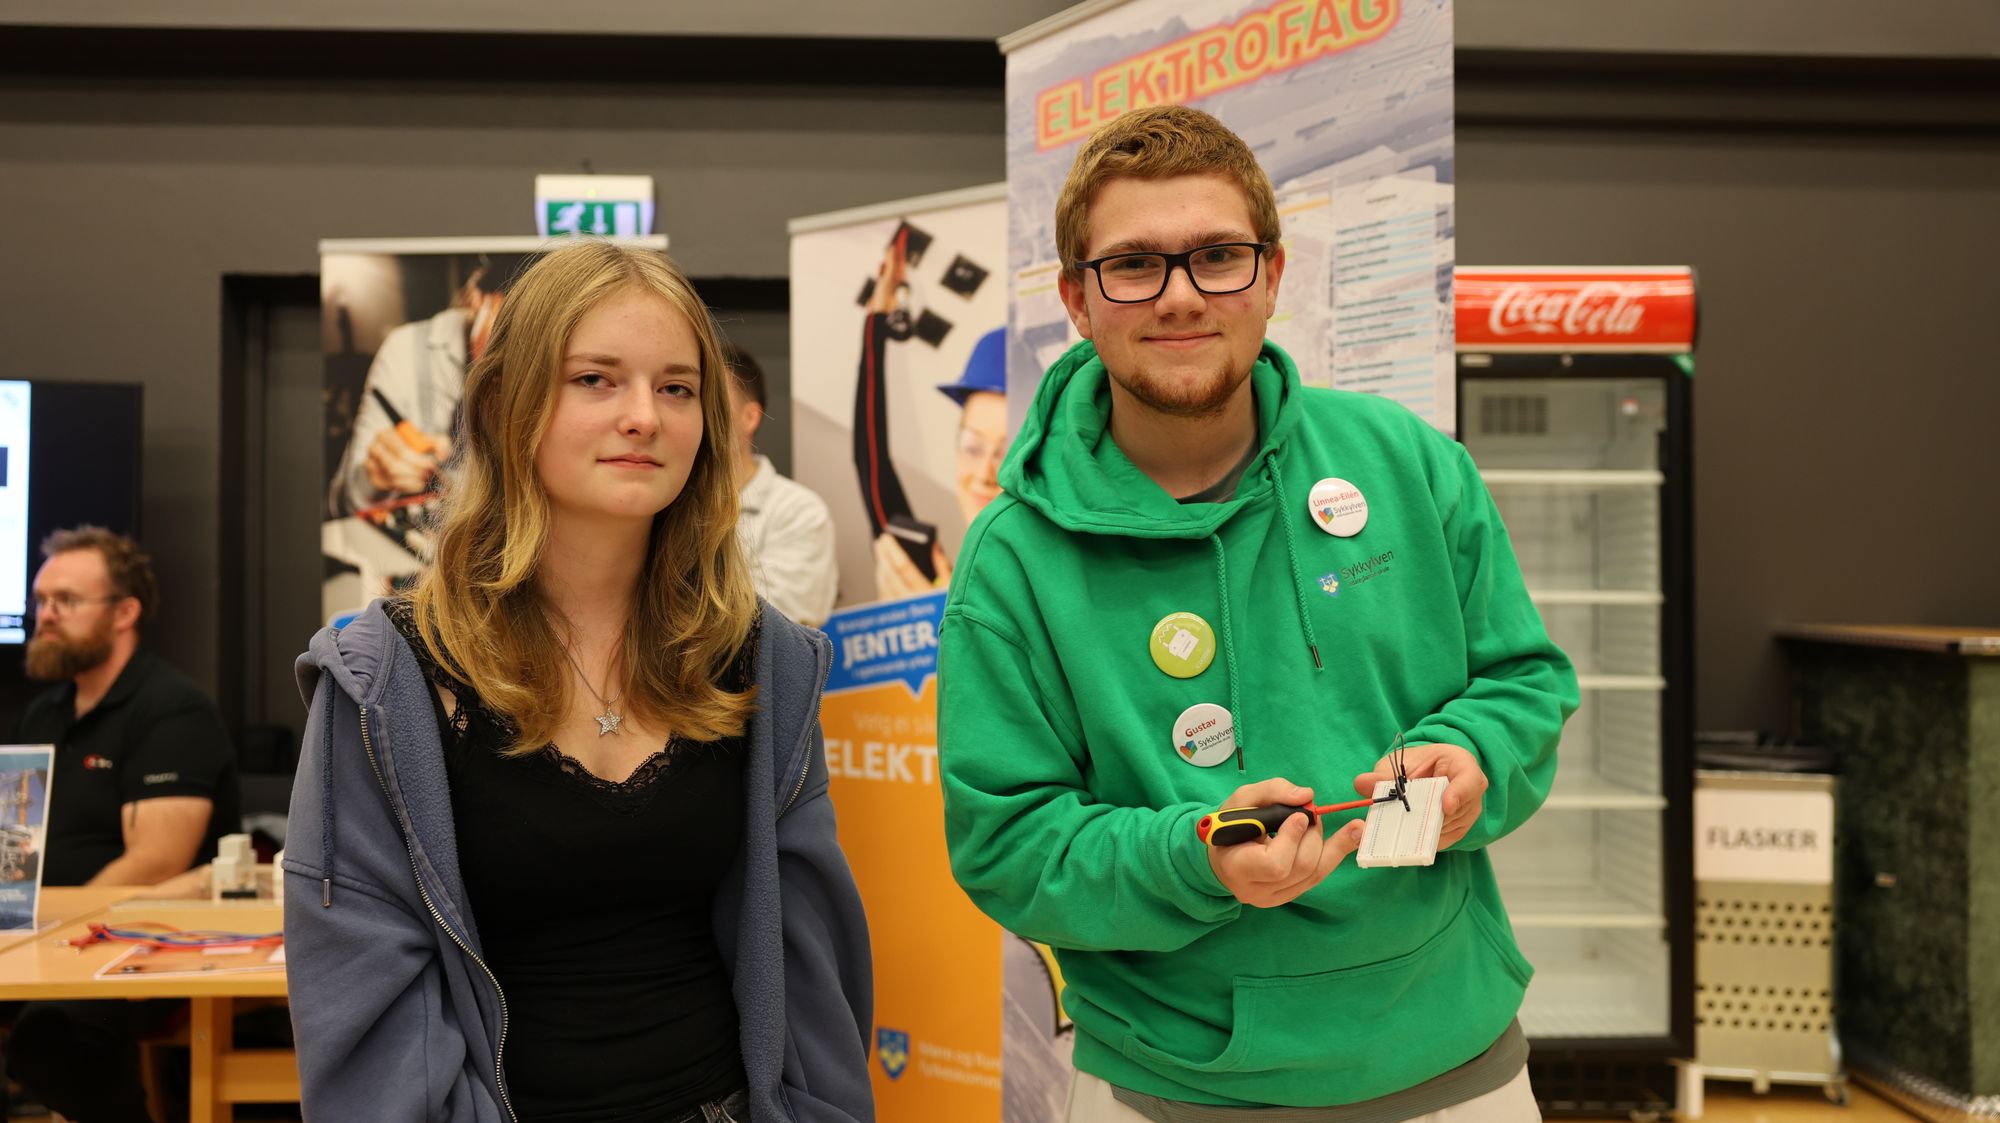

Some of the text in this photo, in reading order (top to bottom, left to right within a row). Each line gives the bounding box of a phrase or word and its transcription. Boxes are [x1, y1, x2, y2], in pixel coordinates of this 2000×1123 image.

[1041, 0, 1396, 142] ELEKTROFAG
[1488, 281, 1648, 336] Coca-Cola
[1333, 501, 1366, 515] Sykkylven
[1341, 550, 1394, 580] Sykkylven
[842, 620, 938, 671] JENTER
[1185, 718, 1216, 738] Gustav
[1197, 725, 1235, 748] Sykkylven
[1706, 827, 1819, 851] FLASKER
